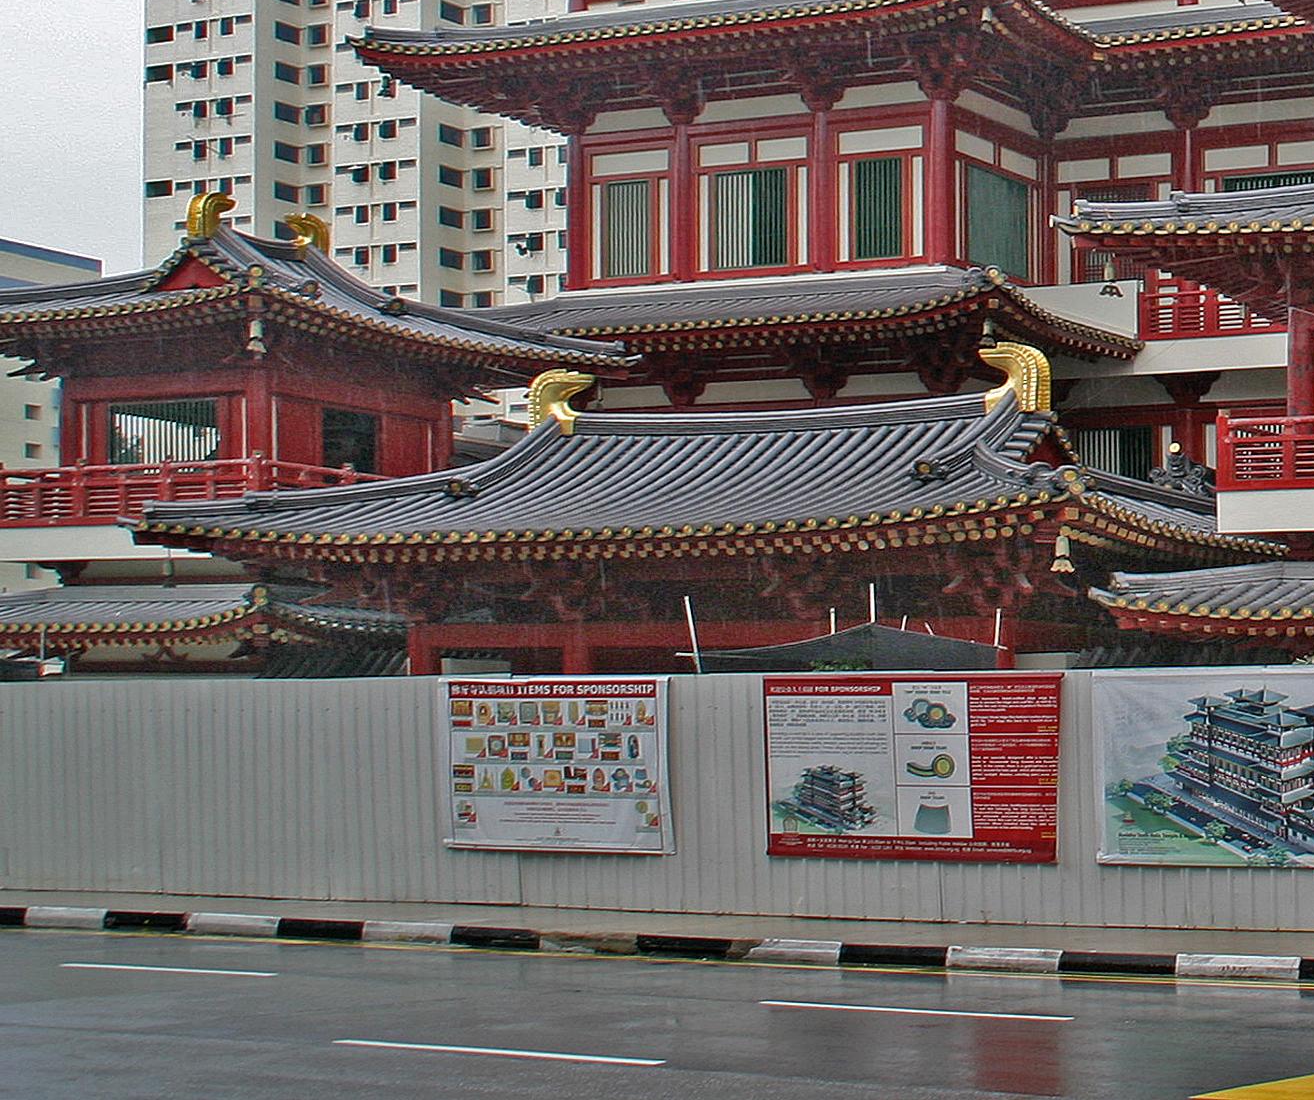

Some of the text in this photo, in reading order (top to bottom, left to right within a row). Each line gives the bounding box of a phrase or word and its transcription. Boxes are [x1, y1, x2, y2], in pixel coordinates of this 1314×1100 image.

[517, 683, 654, 695] ITEMS FOR SPONSORSHIP
